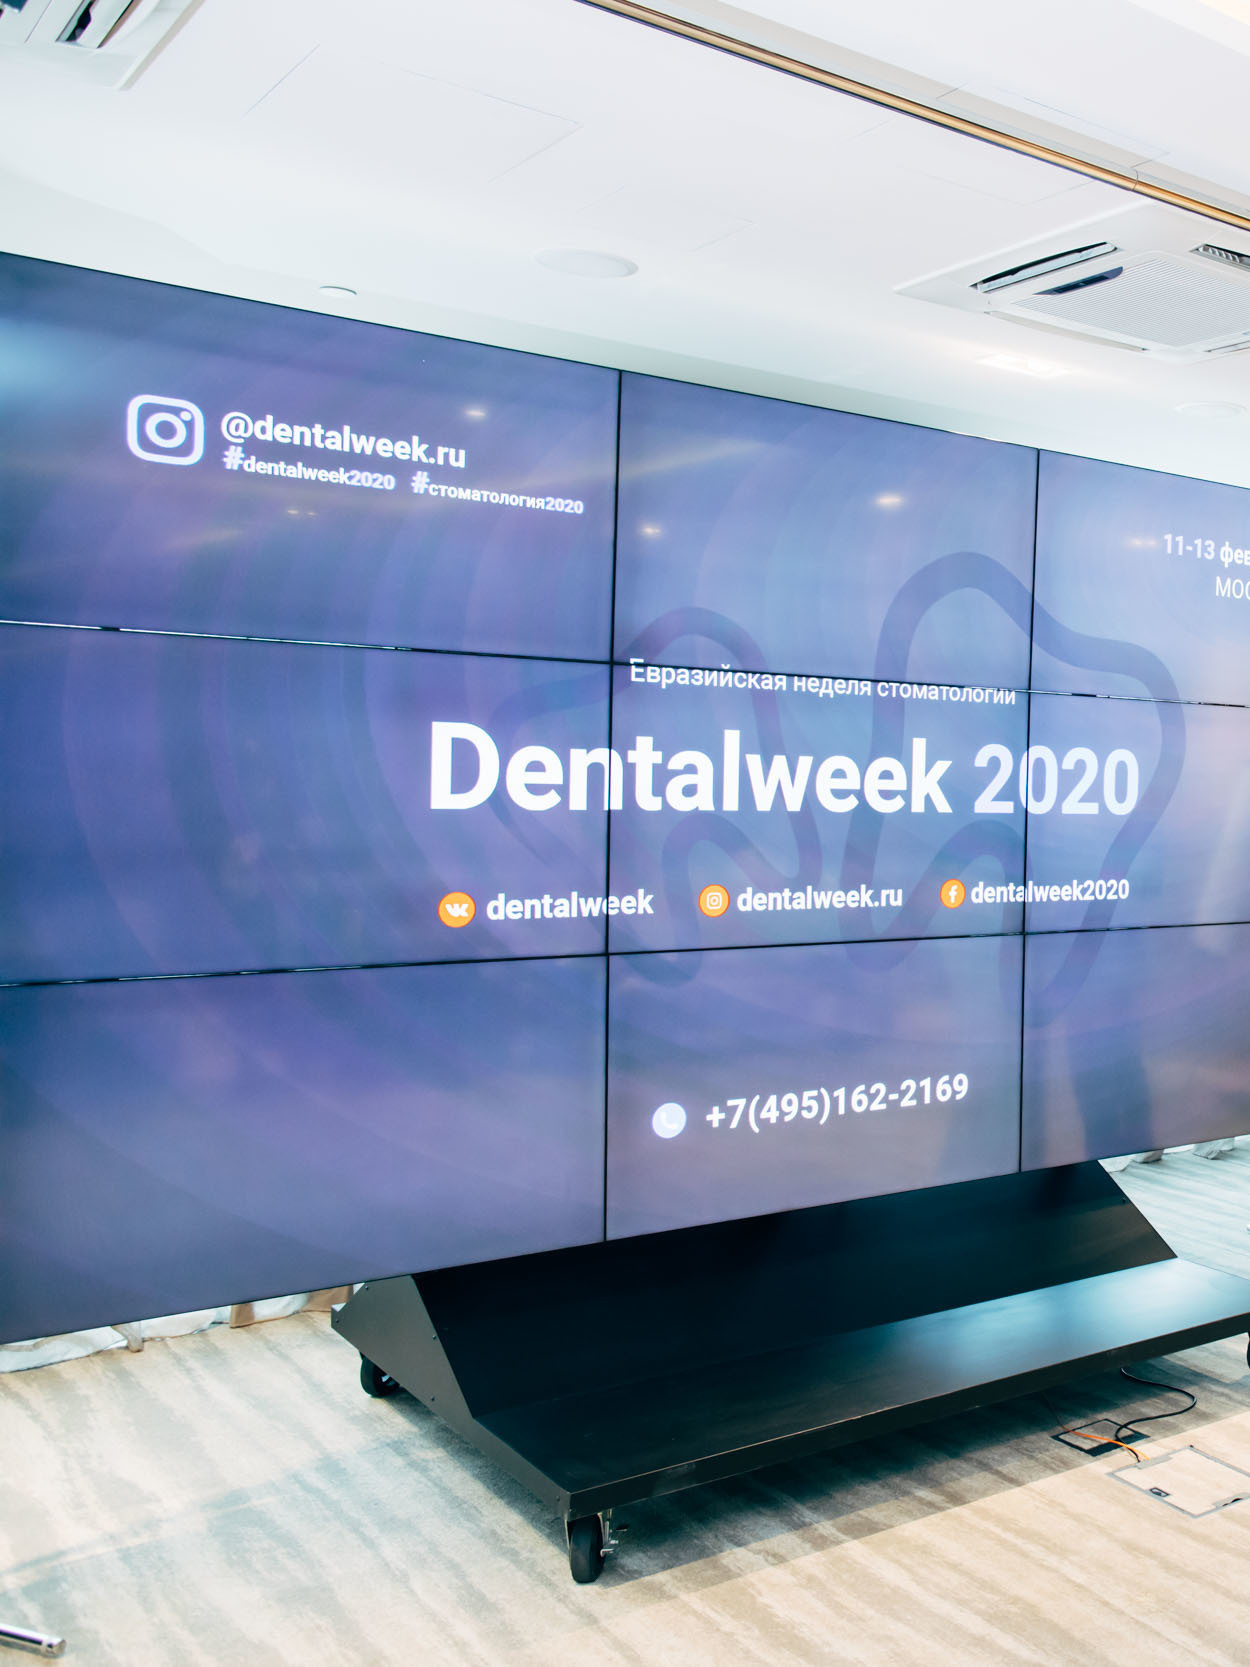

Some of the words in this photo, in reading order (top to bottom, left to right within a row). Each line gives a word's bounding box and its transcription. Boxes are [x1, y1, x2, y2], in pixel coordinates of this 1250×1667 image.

[221, 411, 467, 468] @dentalweek.ru
[222, 446, 396, 491] #dentalweek2020
[411, 471, 584, 514] #стоматология2020
[1163, 533, 1216, 560] 11-13
[629, 657, 787, 691] Евразийская
[793, 675, 871, 698] неделя
[877, 681, 1016, 705] стоматологии
[430, 720, 953, 814] Dentalweek
[973, 743, 1140, 815] 2020
[486, 888, 655, 920] dentalweek
[737, 884, 903, 911] dentalweek.ru
[971, 879, 1130, 903] dentalweek2020
[706, 1073, 969, 1133] +7(495)162-2169
